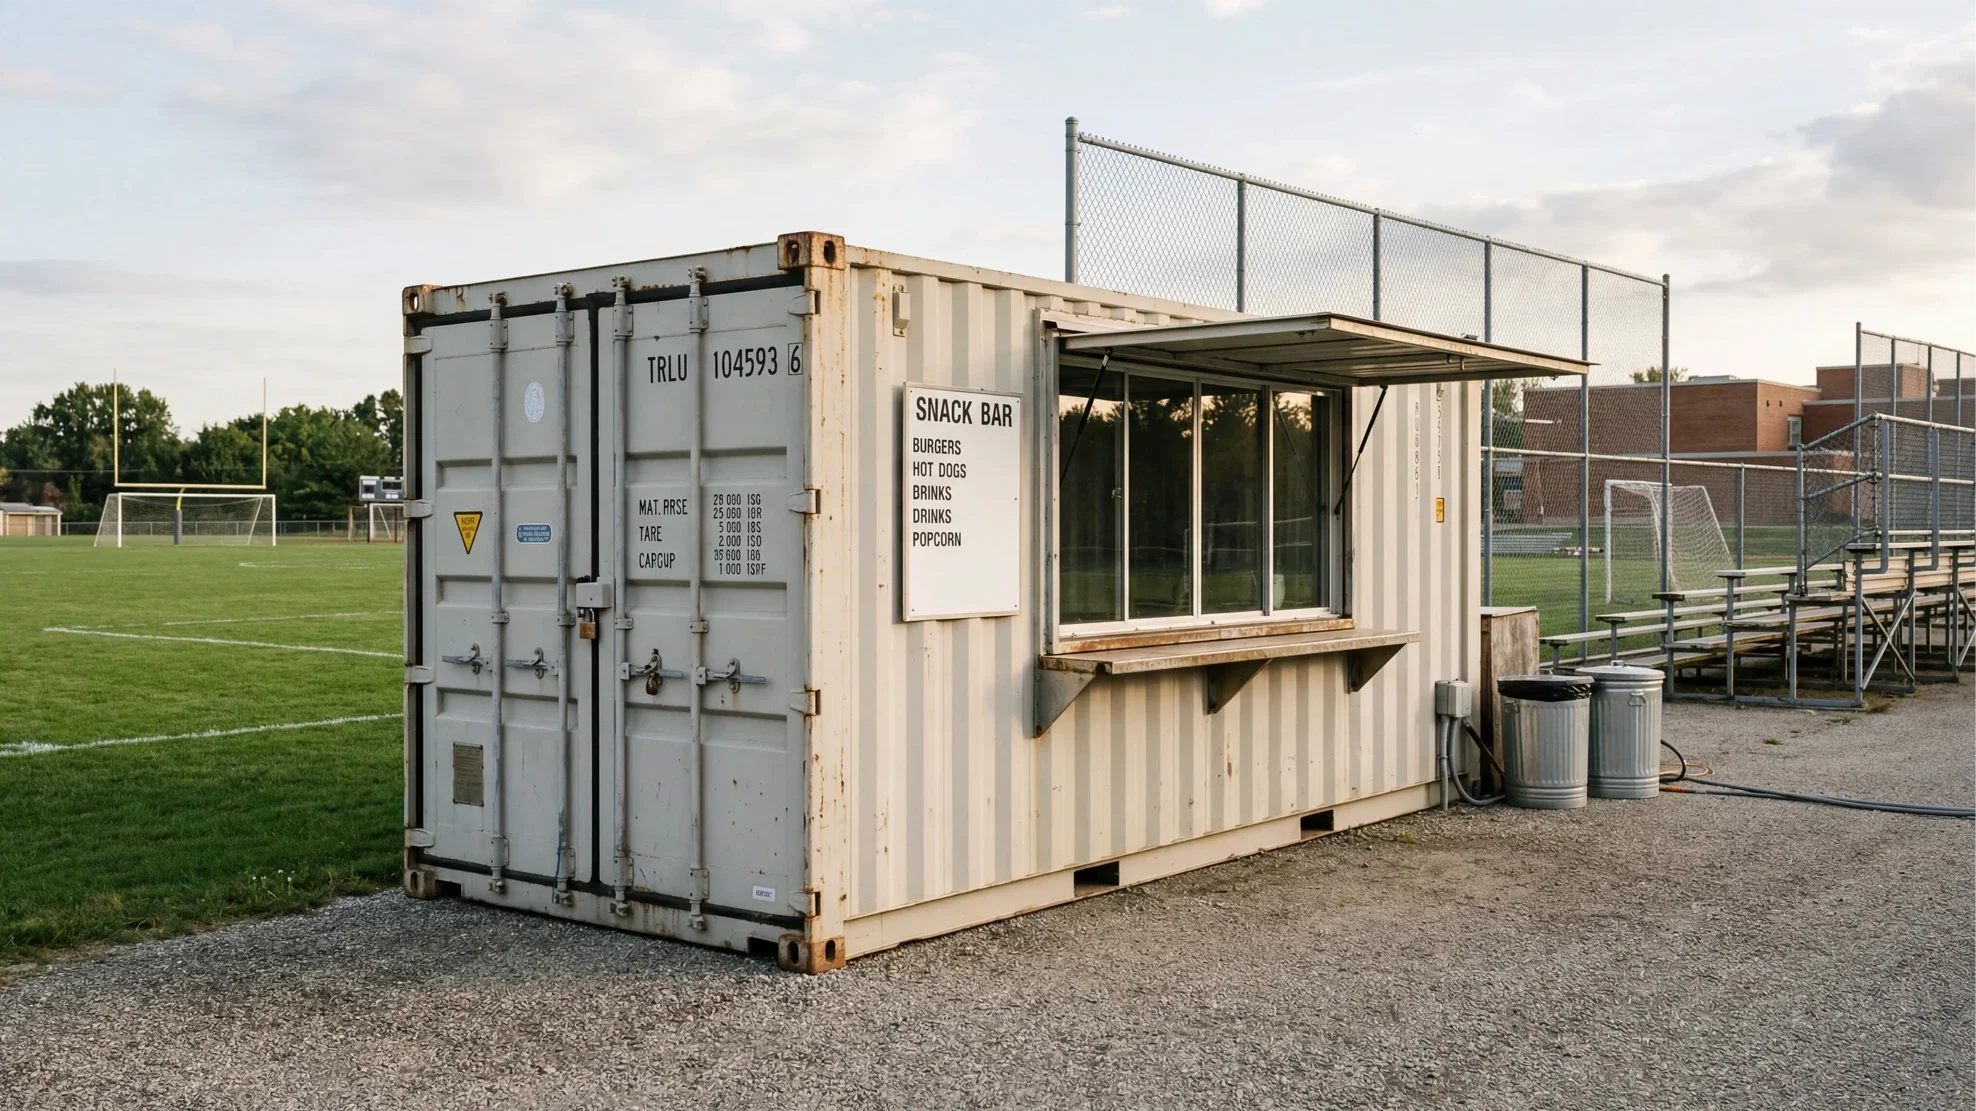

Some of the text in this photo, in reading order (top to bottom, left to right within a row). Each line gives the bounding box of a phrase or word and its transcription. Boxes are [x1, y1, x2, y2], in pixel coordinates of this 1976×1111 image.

[647, 344, 801, 384] TRLU 104593 6
[916, 396, 1013, 428] SNACK BAR
[912, 437, 962, 456] BURGERS
[912, 461, 967, 479] HOT DOGS
[912, 484, 952, 501] BRINKS
[639, 499, 661, 516] MAT.
[713, 507, 724, 519] 25
[912, 508, 952, 524] DRINKS
[639, 525, 662, 542] TARE
[718, 521, 724, 533] 5
[718, 535, 725, 547] 2
[726, 535, 742, 547] 000
[912, 531, 962, 547] POPCORN
[719, 562, 723, 575] 1
[725, 562, 742, 575] 000
